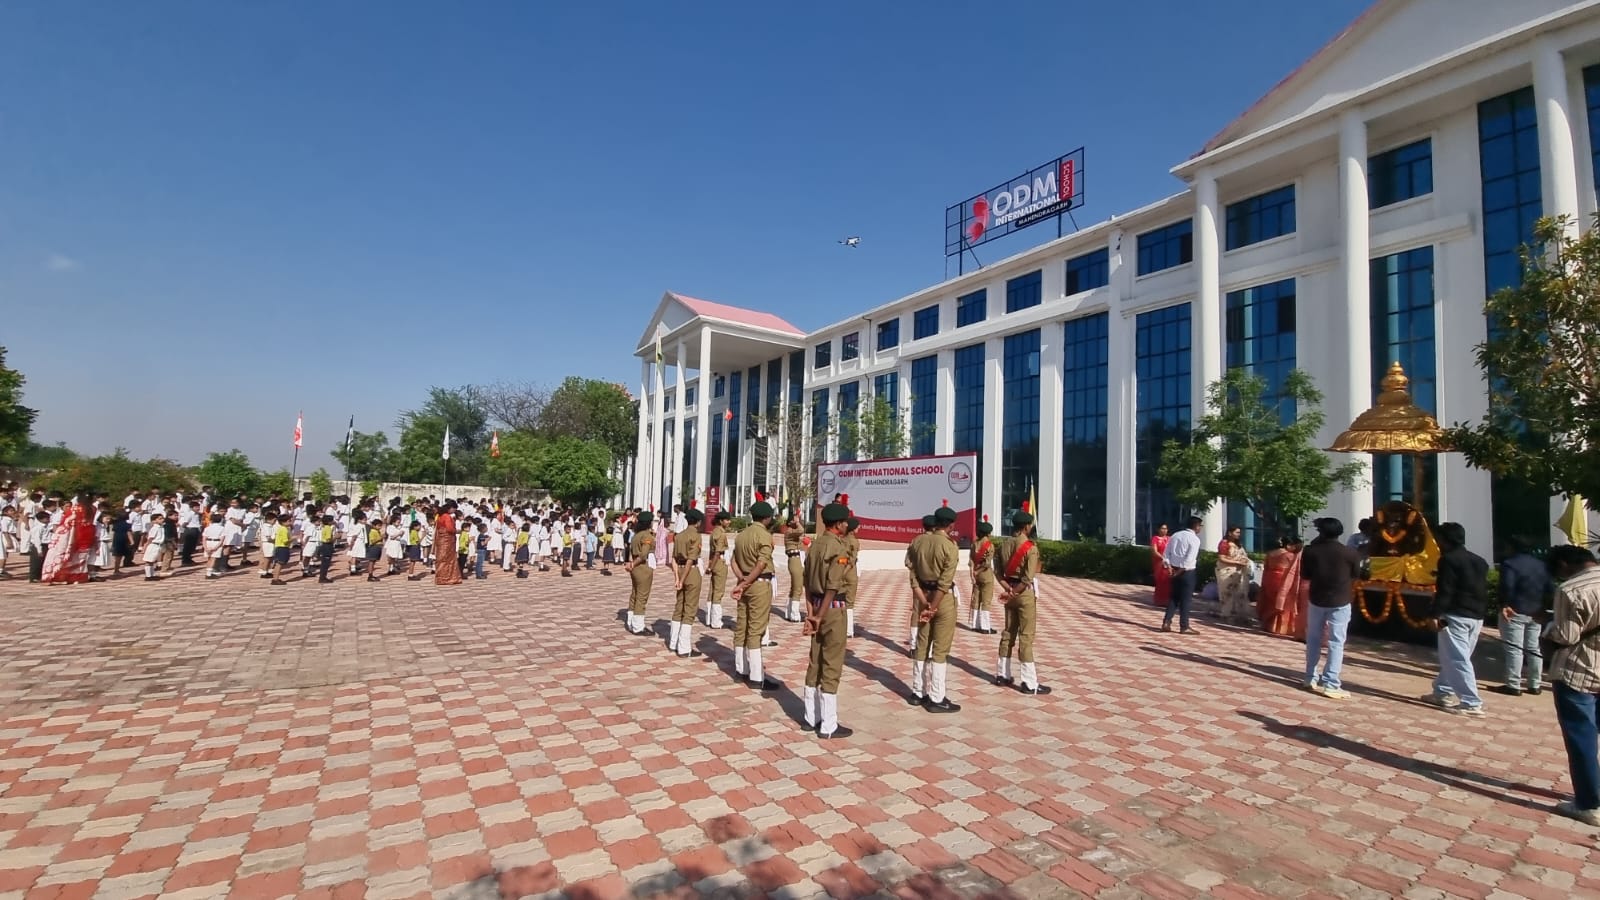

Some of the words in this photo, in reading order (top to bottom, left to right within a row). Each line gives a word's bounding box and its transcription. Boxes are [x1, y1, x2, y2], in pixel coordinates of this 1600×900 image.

[992, 171, 1057, 217] ODM
[1062, 163, 1070, 198] SCHOOL
[995, 193, 1061, 226] INTERNATIONAL
[1018, 202, 1068, 225] MAHENDRAGARH
[839, 470, 853, 478] ODM
[854, 467, 909, 477] INTERNATIONAL
[911, 465, 944, 474] SCHOOL
